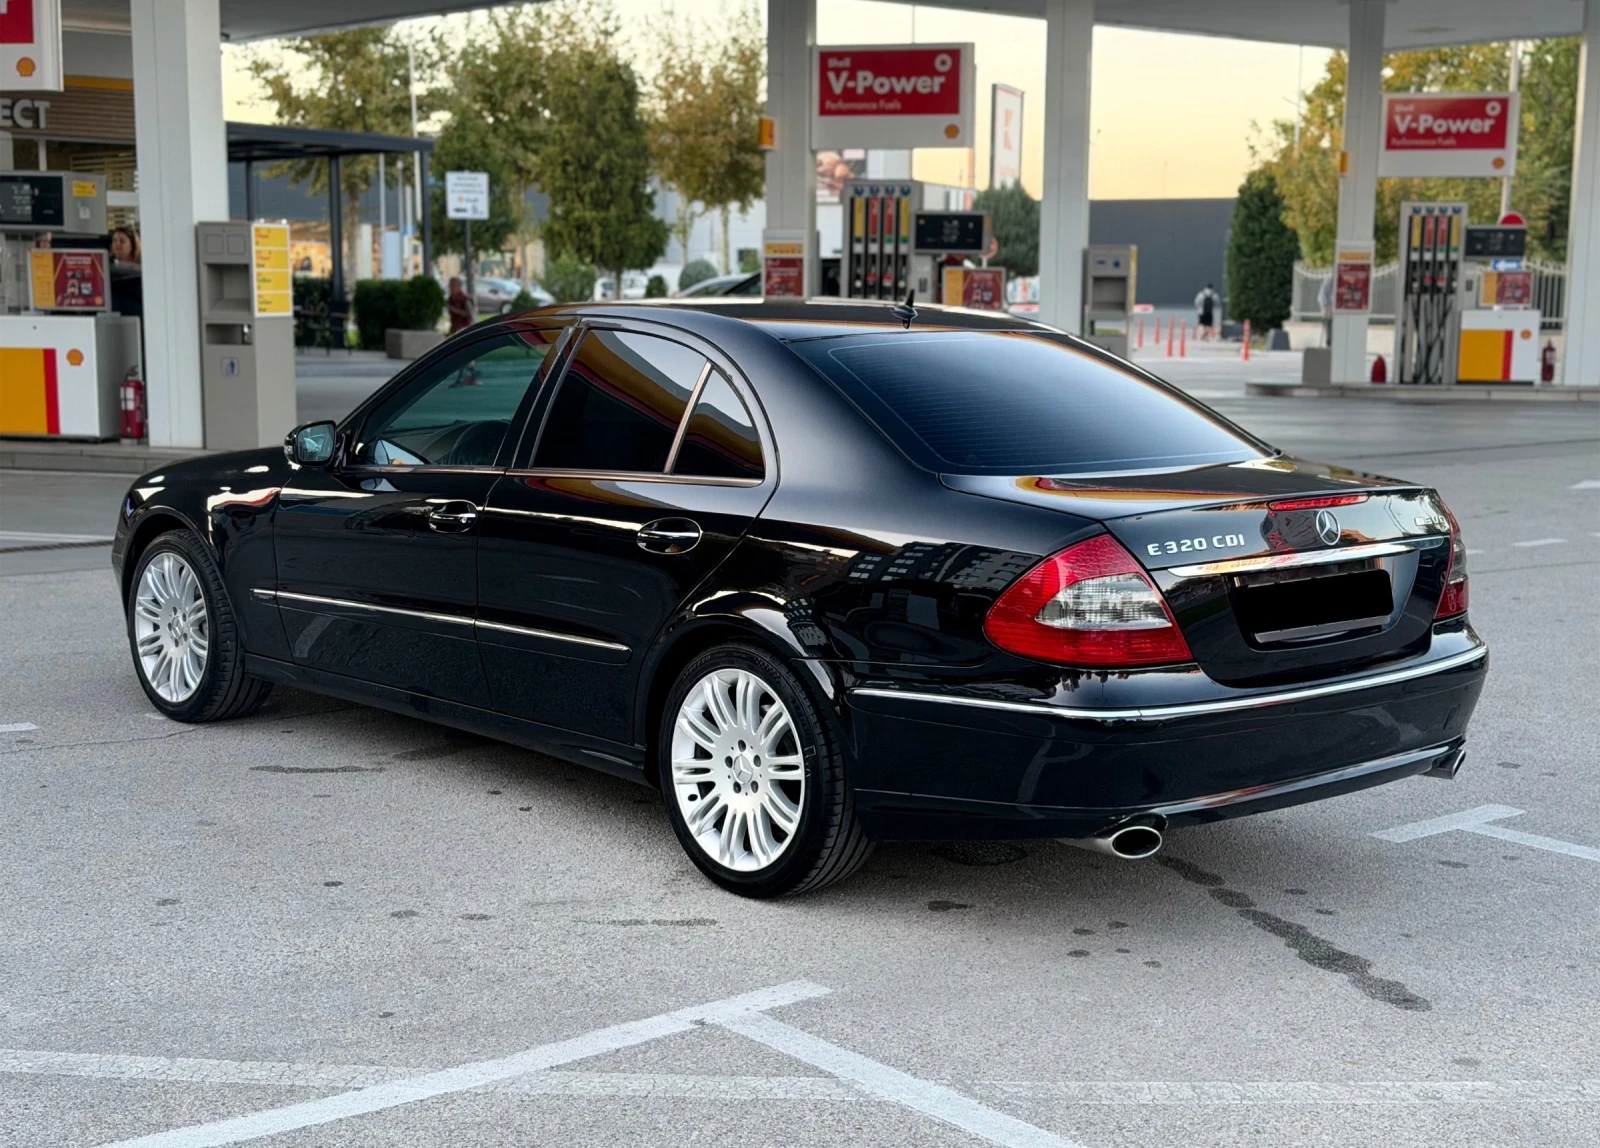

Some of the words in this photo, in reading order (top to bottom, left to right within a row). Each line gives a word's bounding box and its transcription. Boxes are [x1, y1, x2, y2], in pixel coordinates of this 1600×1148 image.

[827, 57, 851, 69] Shell
[826, 70, 946, 95] V-Power
[1394, 114, 1495, 134] V-Power
[1147, 543, 1162, 556] E
[1164, 537, 1207, 554] 320
[1212, 533, 1245, 549] CDI
